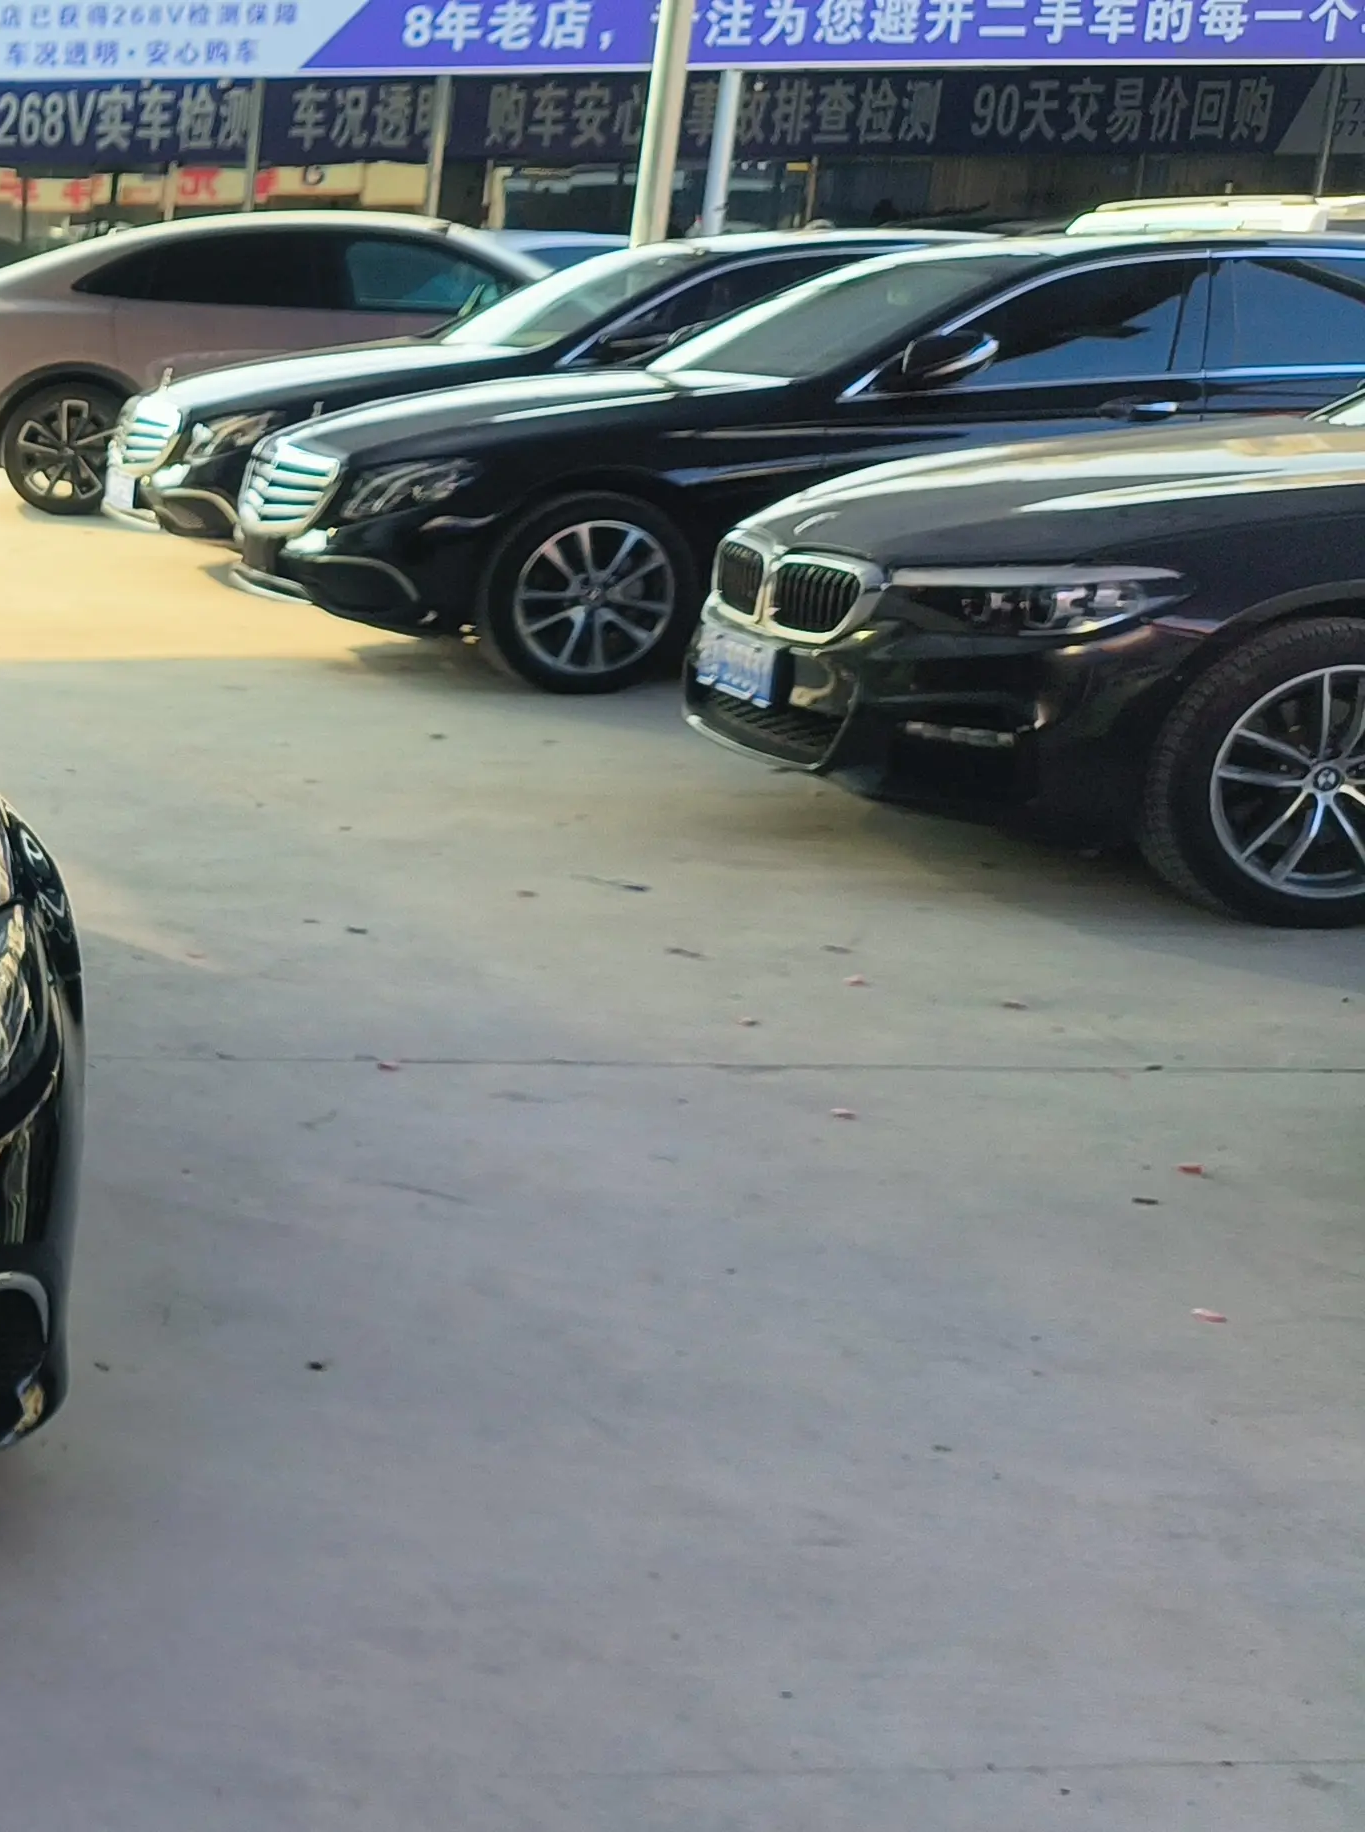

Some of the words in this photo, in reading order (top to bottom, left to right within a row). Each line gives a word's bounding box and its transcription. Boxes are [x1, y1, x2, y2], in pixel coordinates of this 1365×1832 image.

[485, 80, 645, 149] 购车安心
[969, 76, 1275, 144] 90天交易价回购
